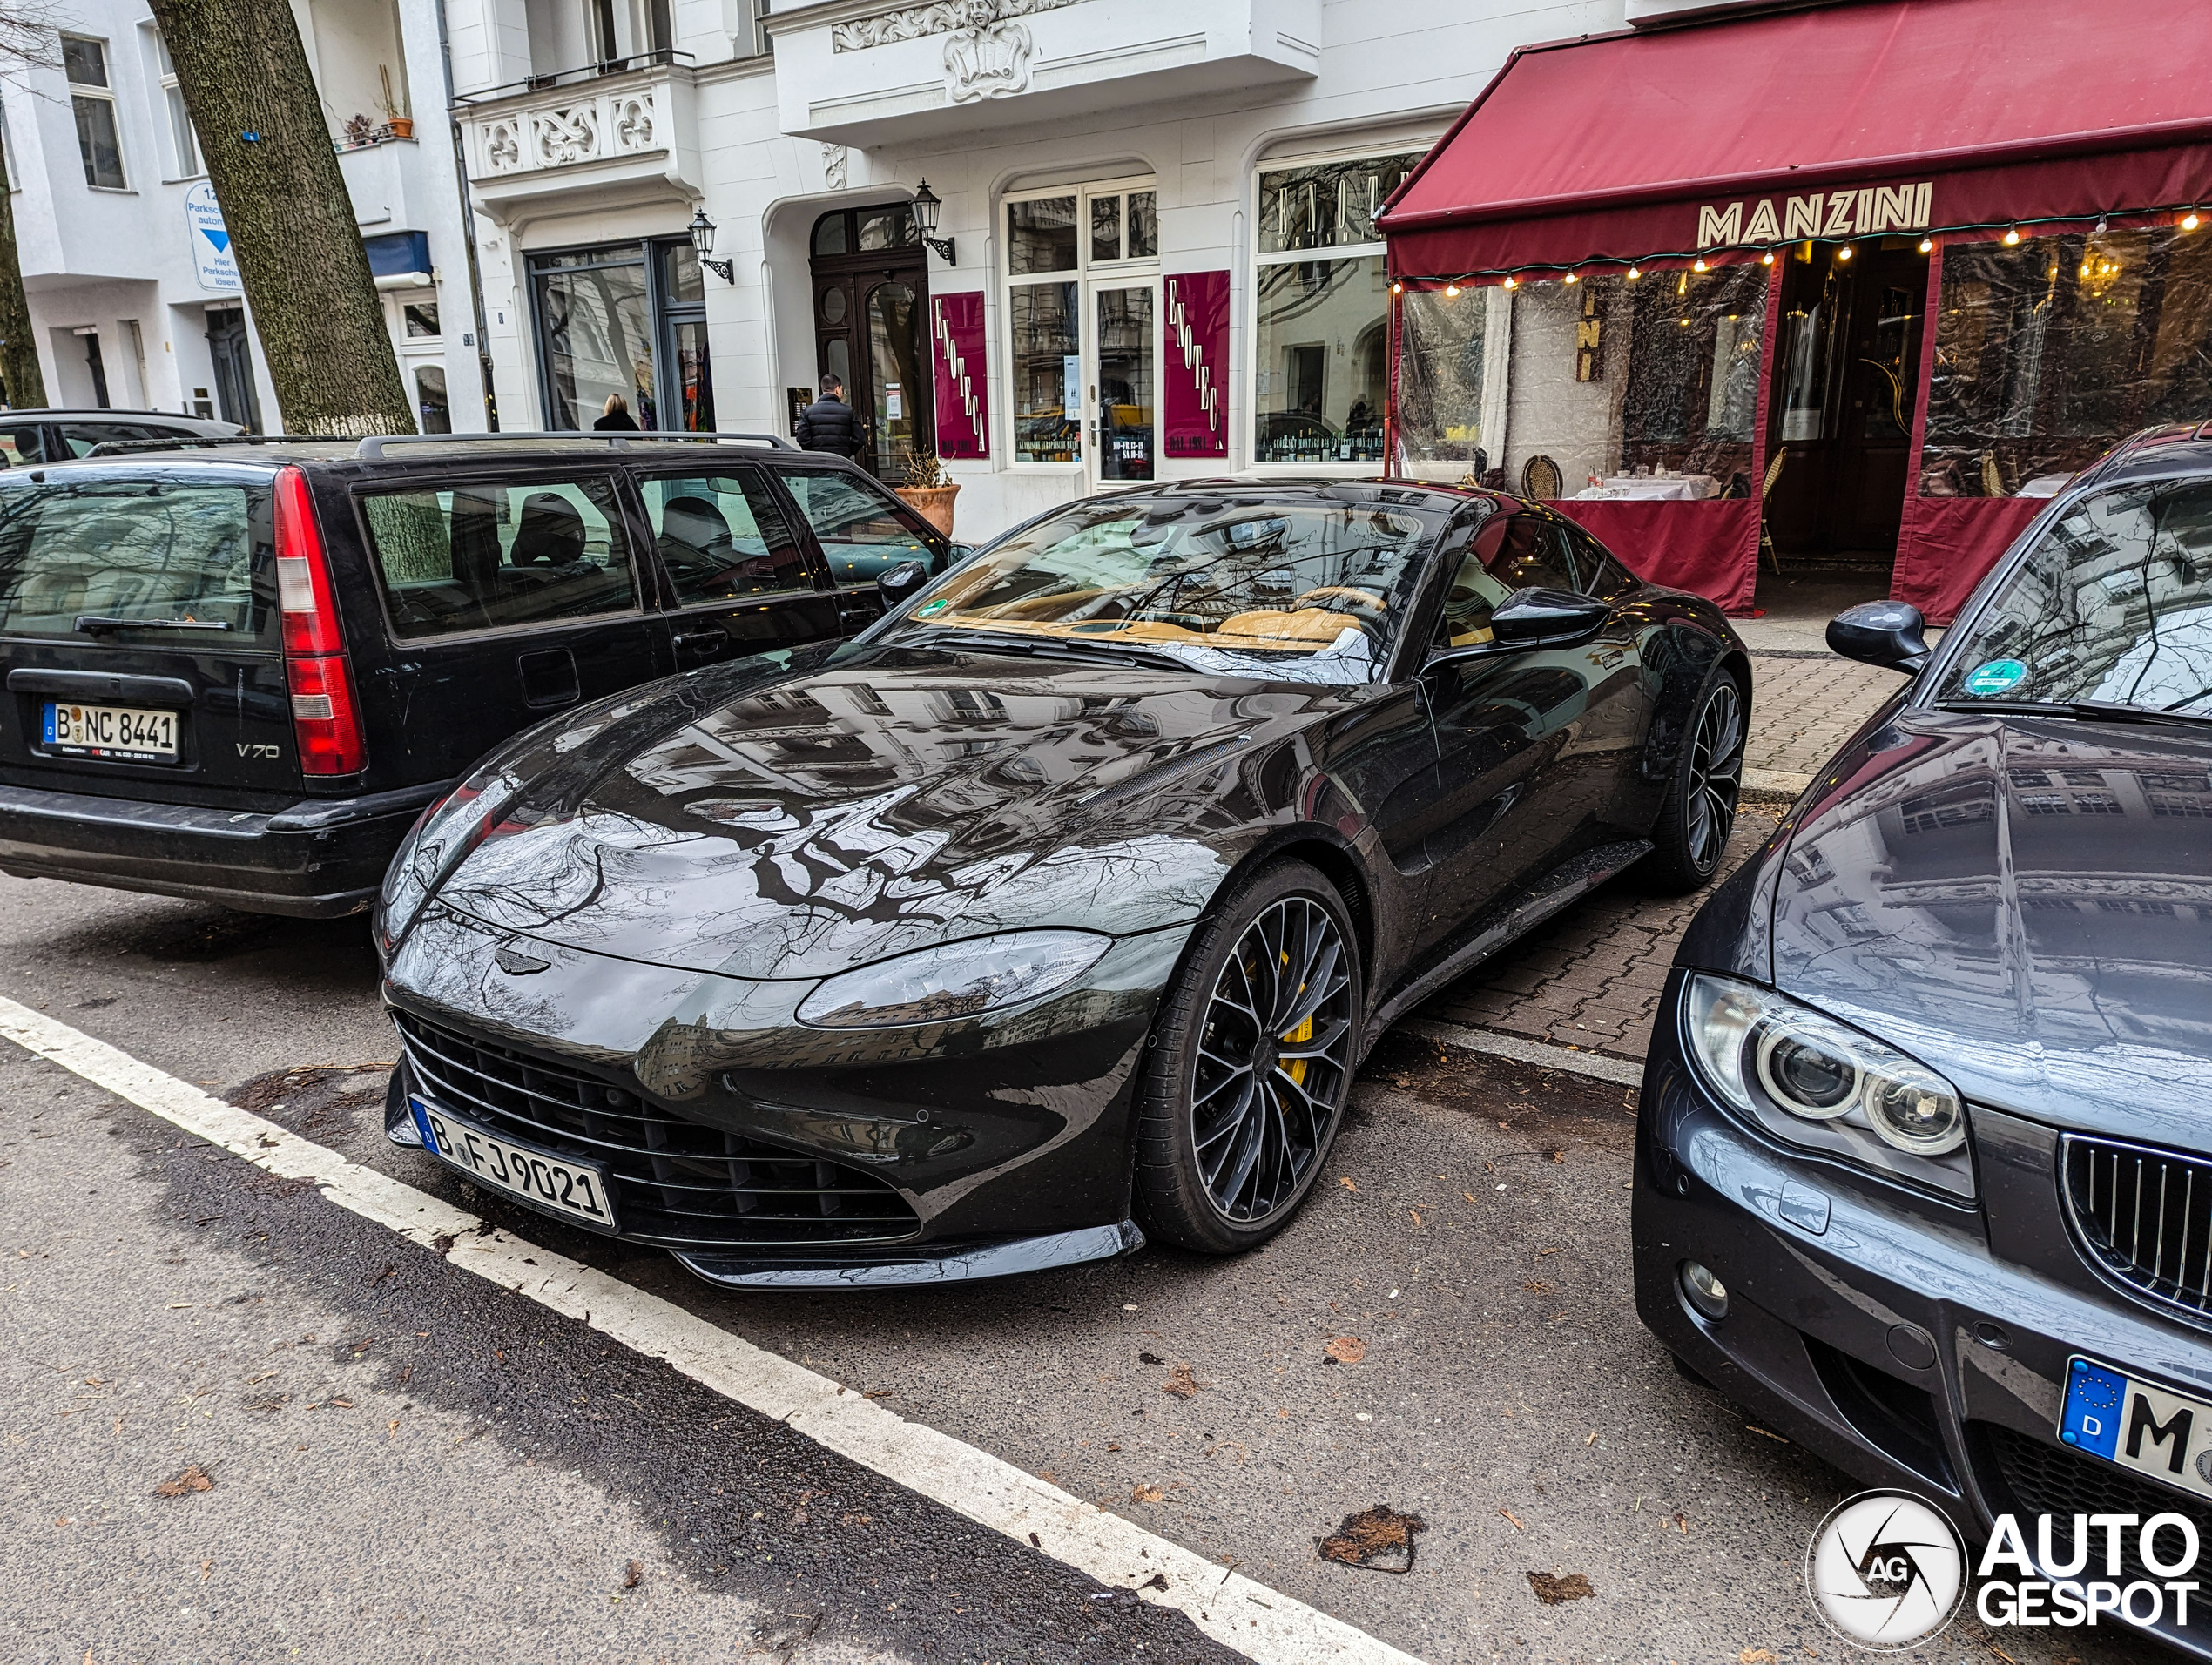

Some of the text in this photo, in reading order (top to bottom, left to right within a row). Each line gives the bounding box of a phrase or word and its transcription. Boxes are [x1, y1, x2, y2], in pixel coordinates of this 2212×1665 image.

[1279, 172, 1409, 235] ENOT
[1697, 182, 1933, 248] MANZINI
[214, 258, 230, 266] Hier
[203, 266, 239, 277] Parksche
[215, 278, 237, 286] lösen
[1169, 280, 1224, 450] ENOTECA
[935, 299, 985, 451] ENOTECA
[1113, 441, 1130, 450] MO-FR
[1123, 450, 1130, 459] SA
[1991, 664, 2006, 677] 4
[47, 726, 53, 736] D
[57, 709, 173, 748] B NC 8441
[235, 743, 280, 759] V70
[425, 1131, 433, 1143] D
[428, 1114, 453, 1156] B
[2081, 1415, 2102, 1437] D
[2125, 1392, 2195, 1475] M
